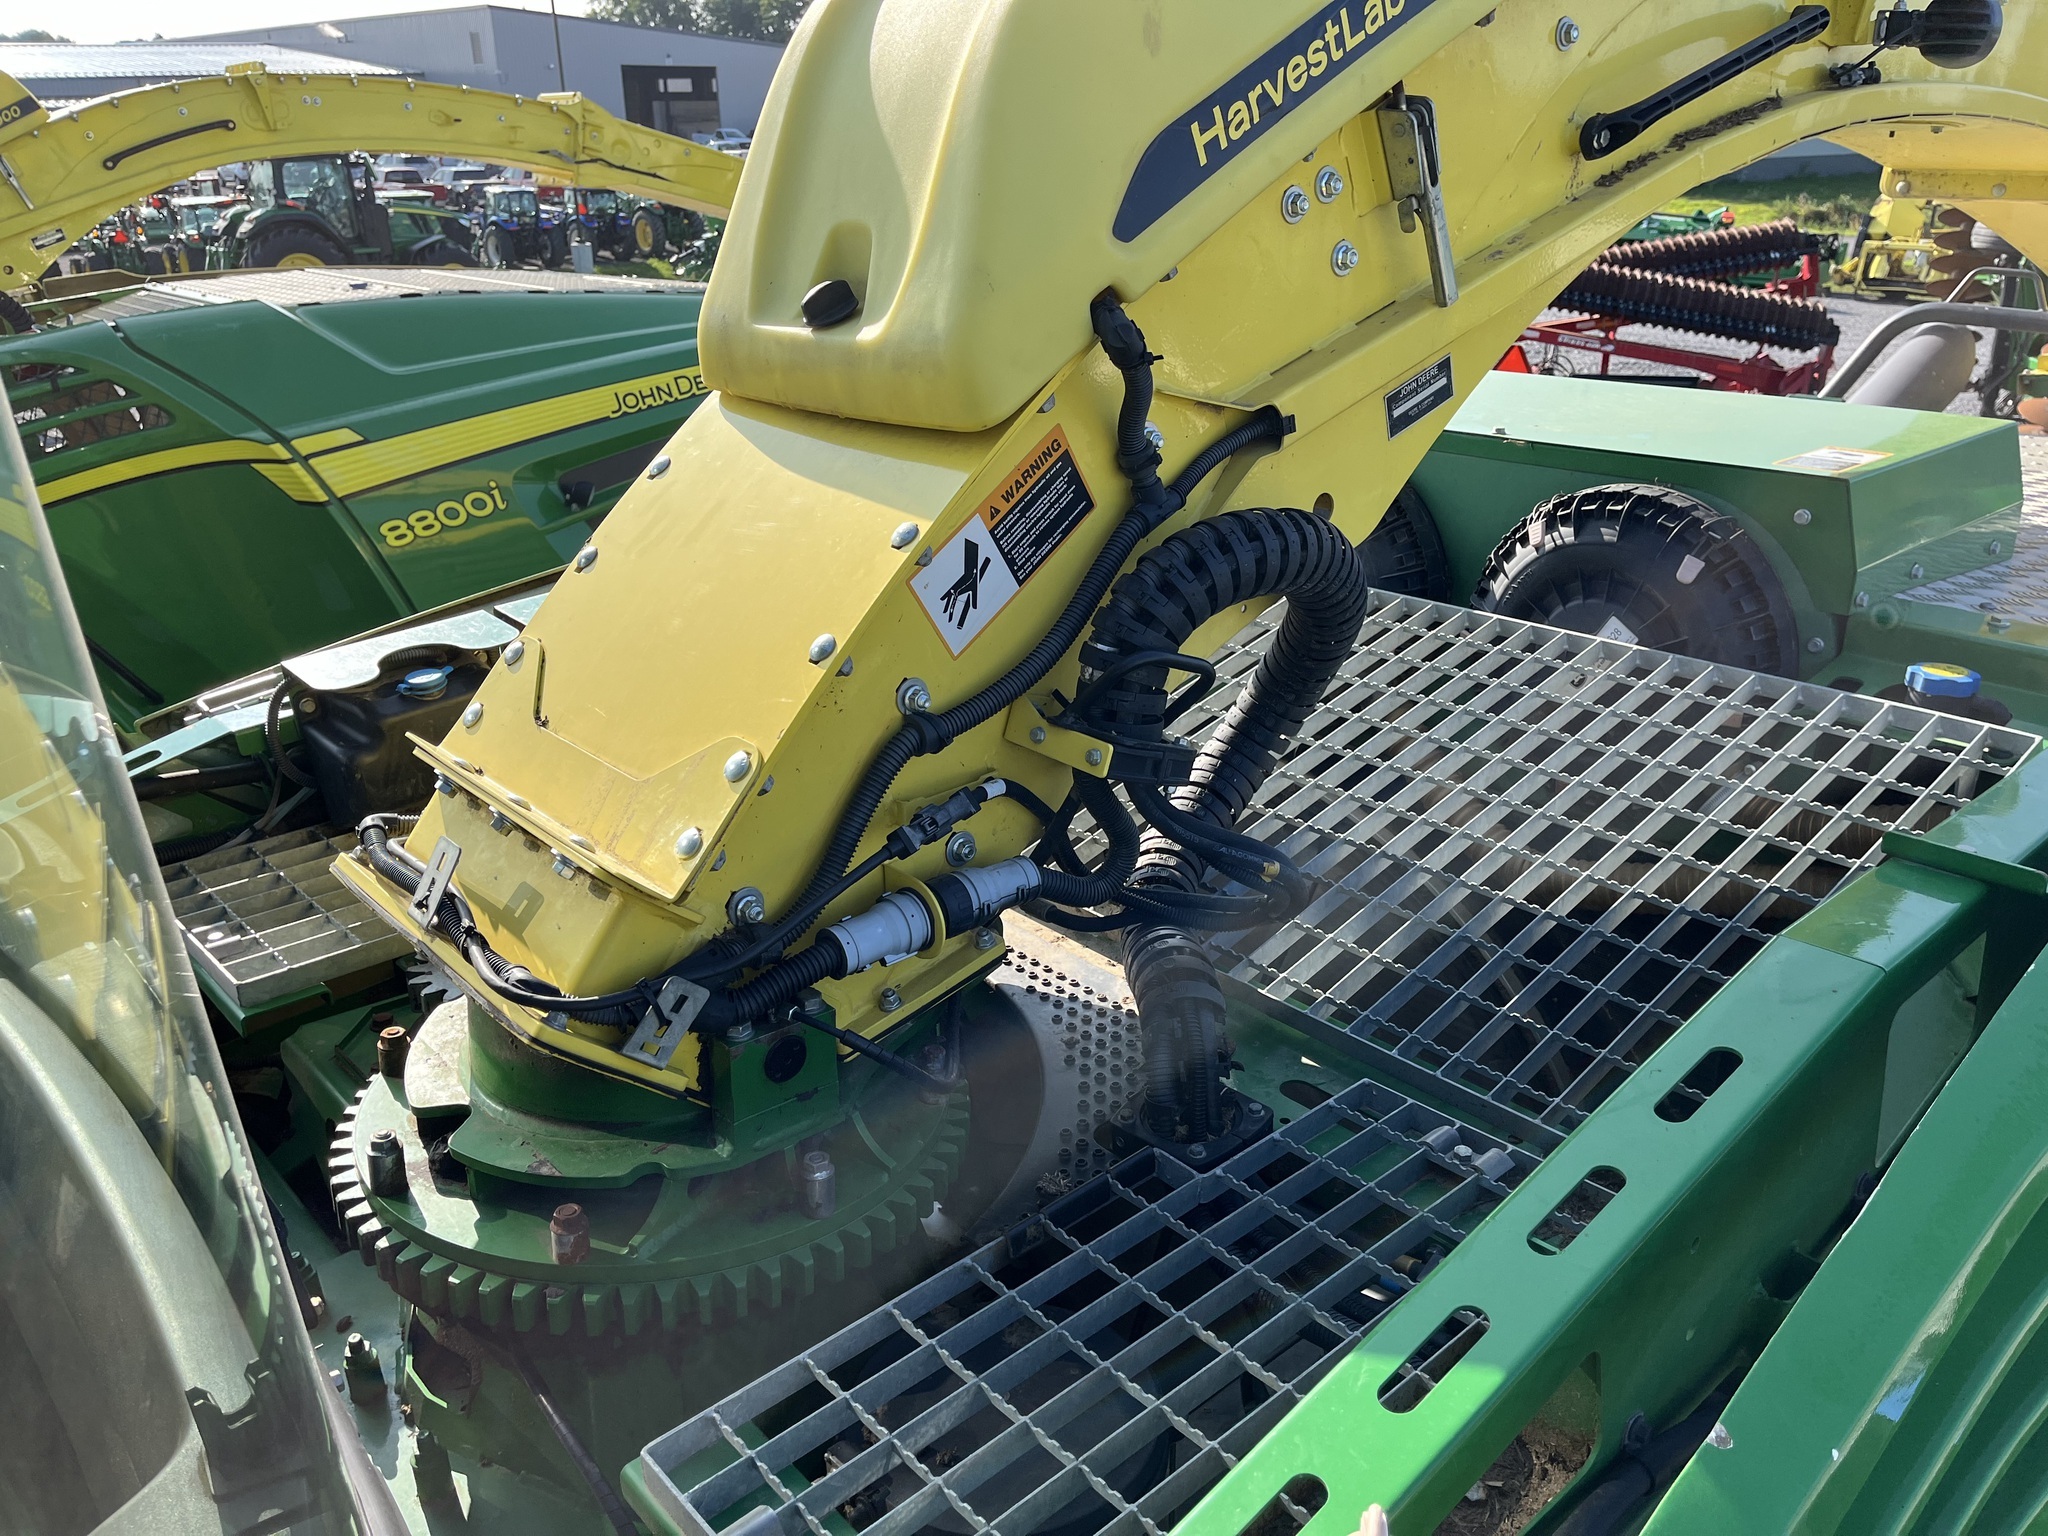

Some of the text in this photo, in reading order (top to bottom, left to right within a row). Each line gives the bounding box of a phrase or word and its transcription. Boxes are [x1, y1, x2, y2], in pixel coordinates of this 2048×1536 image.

[0, 105, 20, 126] 00
[1399, 365, 1439, 398] JOHN DEERE
[1430, 371, 1447, 384] Number
[611, 383, 673, 414] JOHN
[1000, 438, 1062, 504] WARNING
[379, 480, 507, 548] 8800i
